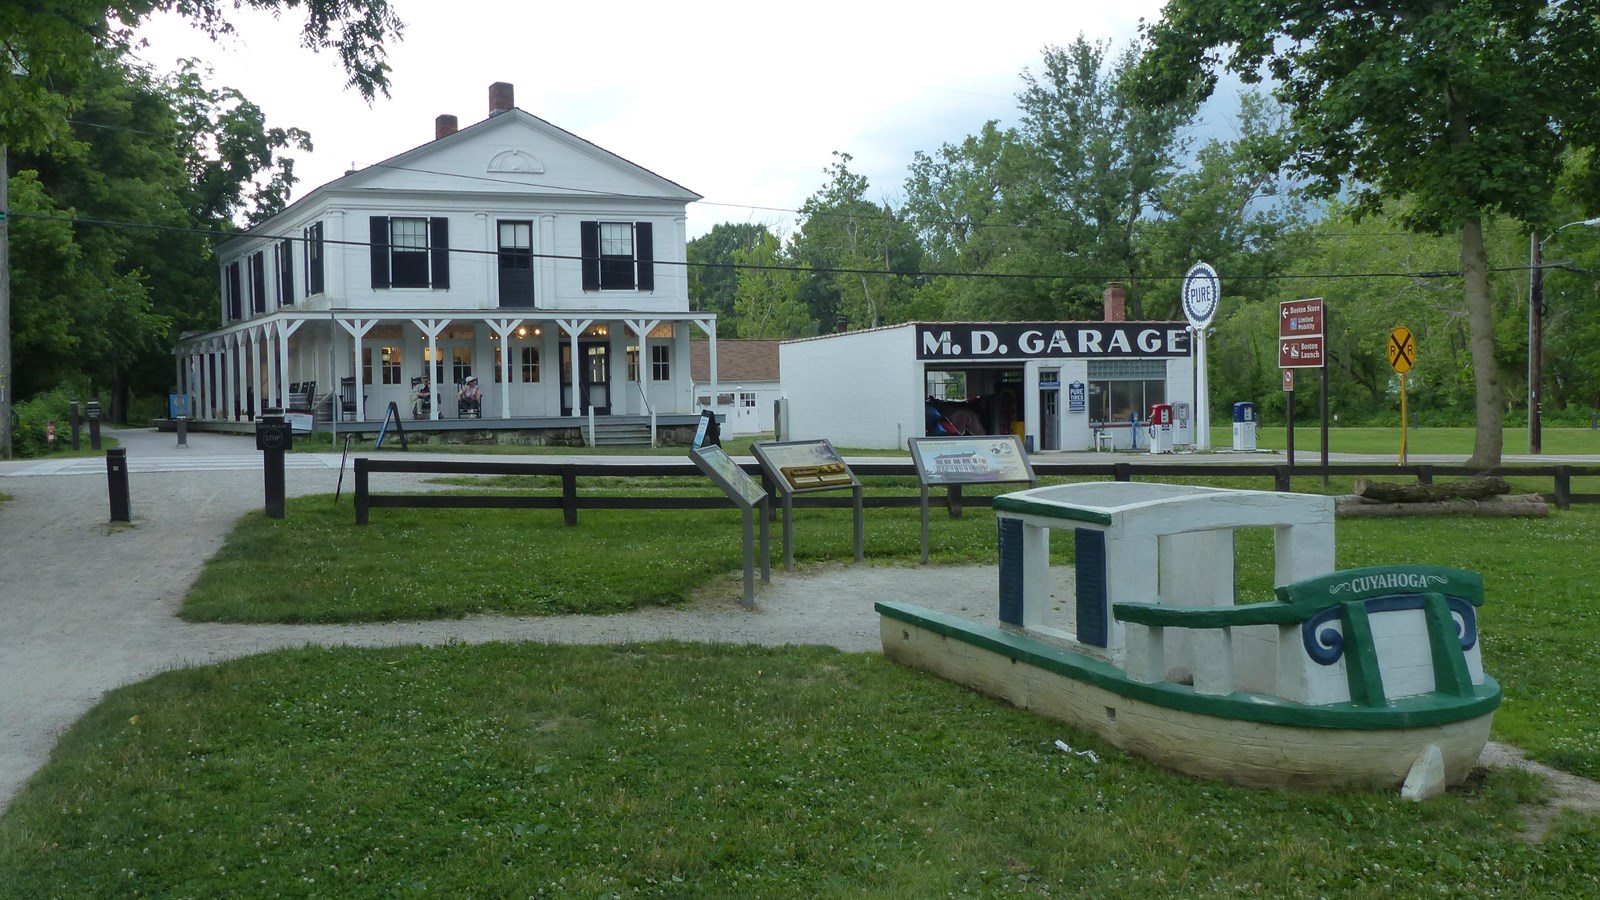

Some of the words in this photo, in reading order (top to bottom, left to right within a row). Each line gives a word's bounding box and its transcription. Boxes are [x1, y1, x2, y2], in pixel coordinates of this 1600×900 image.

[1190, 286, 1211, 304] PURE
[1290, 306, 1306, 314] Boston
[1306, 304, 1320, 312] Store
[923, 330, 962, 355] M.
[971, 330, 1008, 355] D.
[1018, 328, 1187, 354] GARAGE
[1301, 342, 1318, 350] Boston
[1301, 350, 1320, 359] Launch
[1390, 345, 1396, 356] R
[1407, 344, 1414, 355] R
[265, 434, 282, 442] STOP
[1352, 573, 1427, 593] CUYAHOGA
